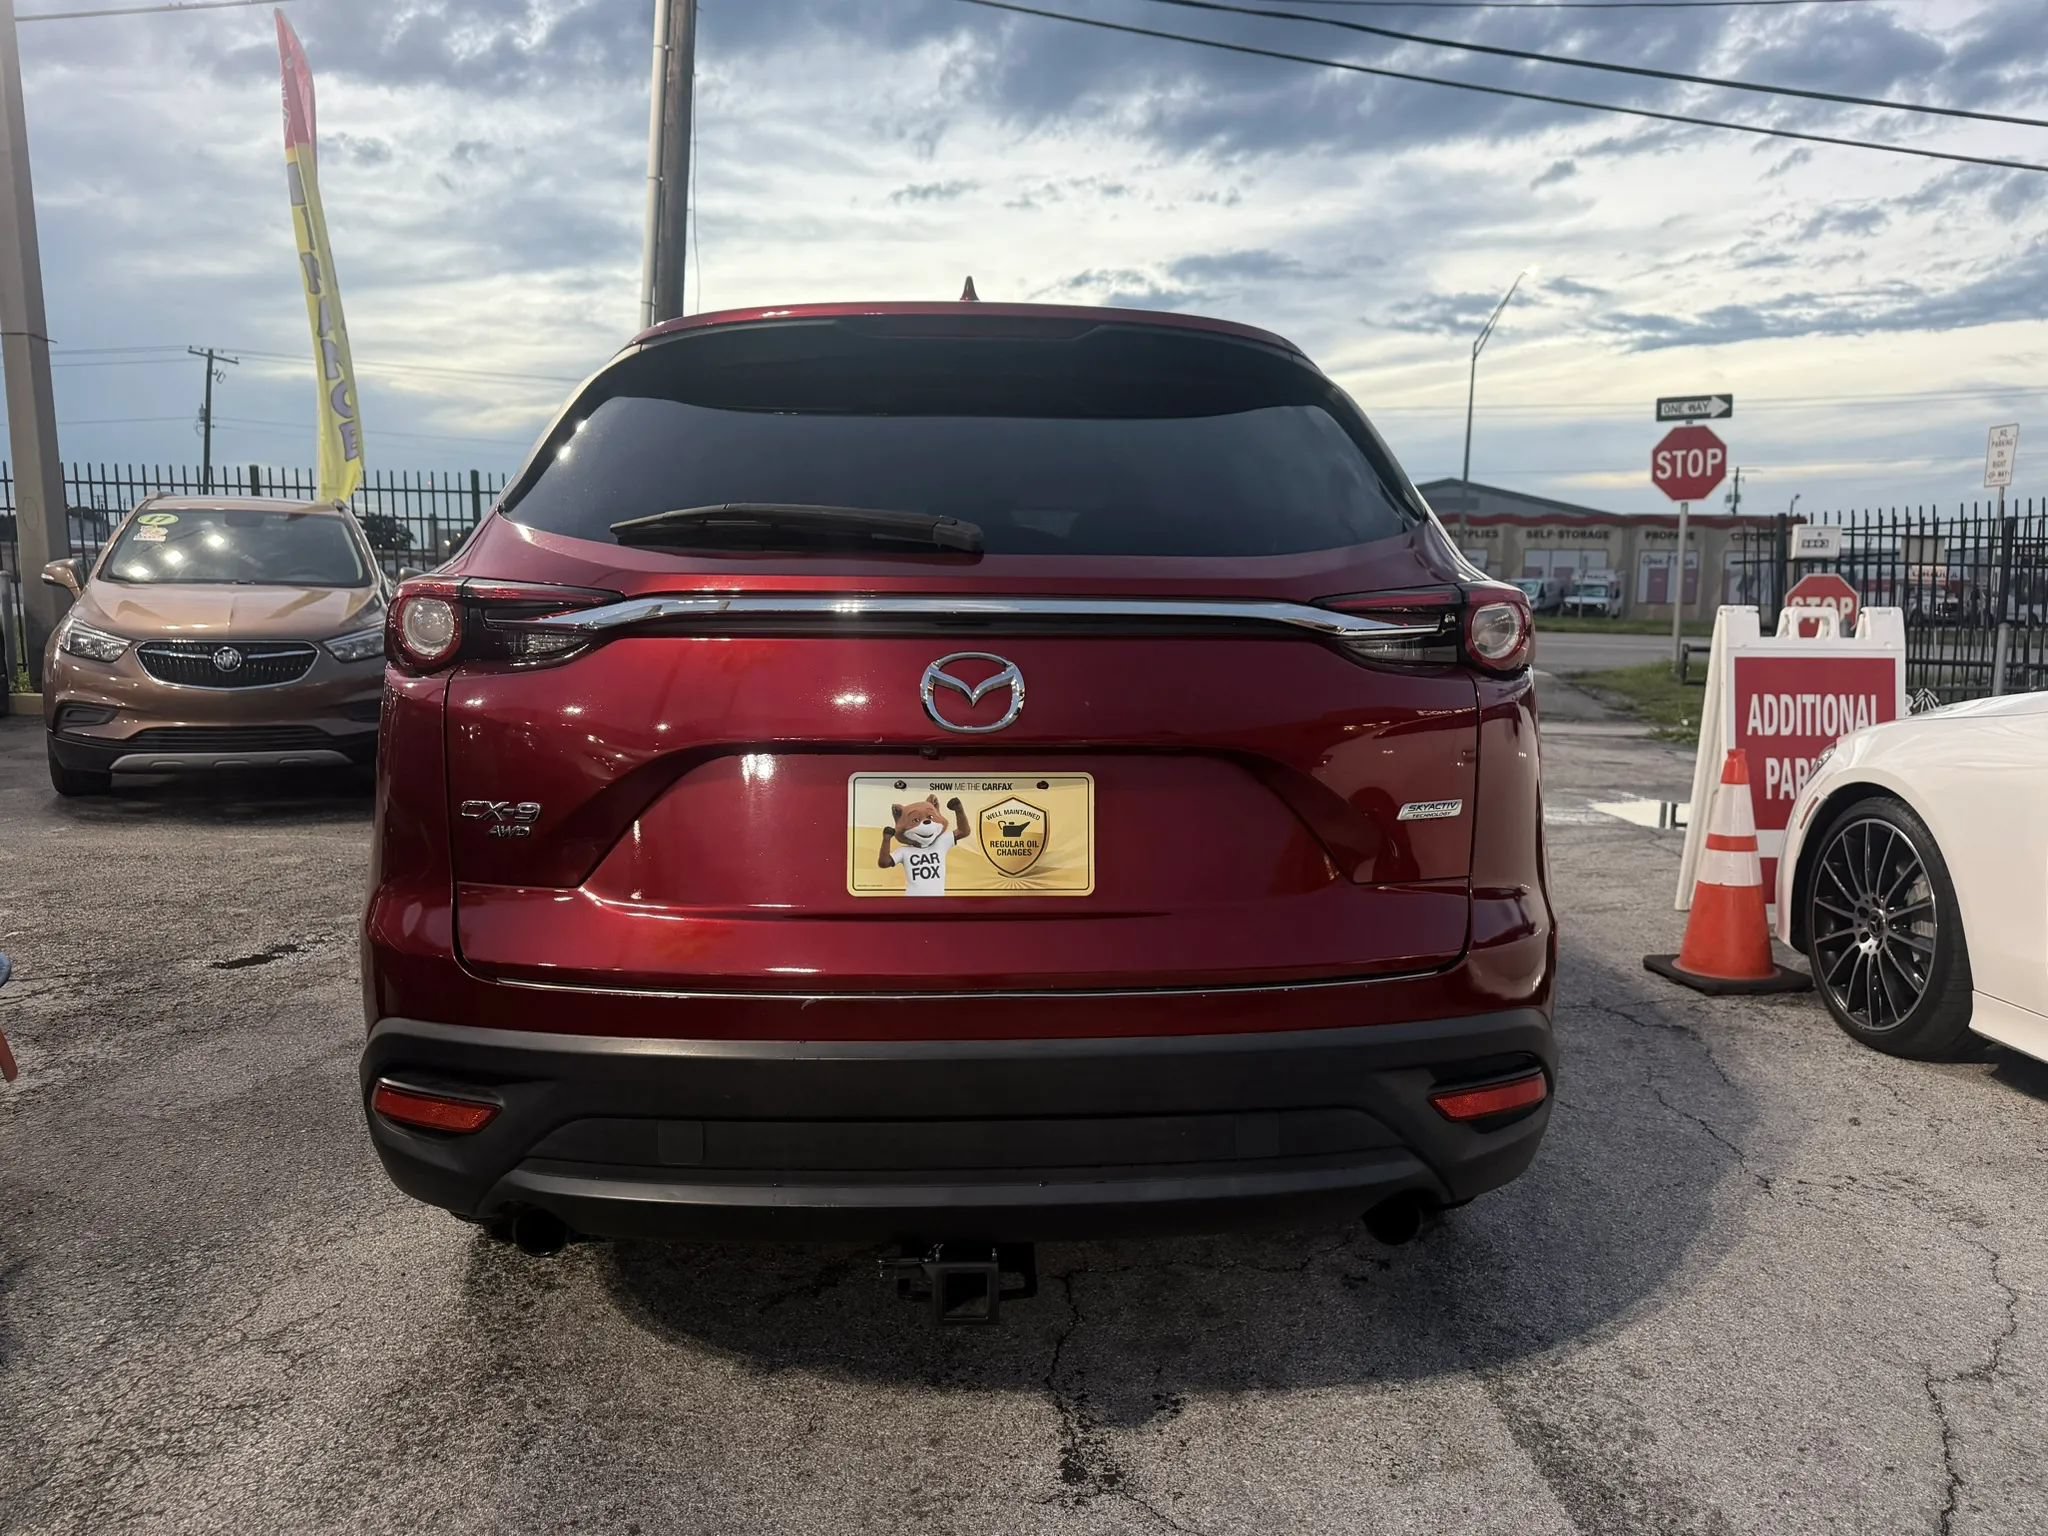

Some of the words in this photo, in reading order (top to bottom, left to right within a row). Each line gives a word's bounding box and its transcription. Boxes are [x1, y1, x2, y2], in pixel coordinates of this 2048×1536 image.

[1663, 403, 1682, 415] ONE
[1687, 401, 1710, 413] WAY
[1656, 448, 1722, 479] STOP
[1747, 693, 1877, 737] ADDITIONAL
[1765, 757, 1816, 800] PAR
[929, 782, 953, 791] SHOW
[954, 782, 966, 791] ME
[967, 782, 981, 791] THE
[981, 782, 1013, 791] CARFAX
[461, 800, 541, 823] CX-9
[986, 809, 1002, 821] WELL
[1003, 808, 1041, 821] MAINTAINED
[1408, 802, 1458, 812] SKYACTIV
[990, 840, 1025, 849] REGULAR
[1026, 840, 1040, 849] OIL
[909, 851, 941, 867] CAR
[996, 848, 1033, 857] CHANGES
[911, 864, 941, 881] FOX
